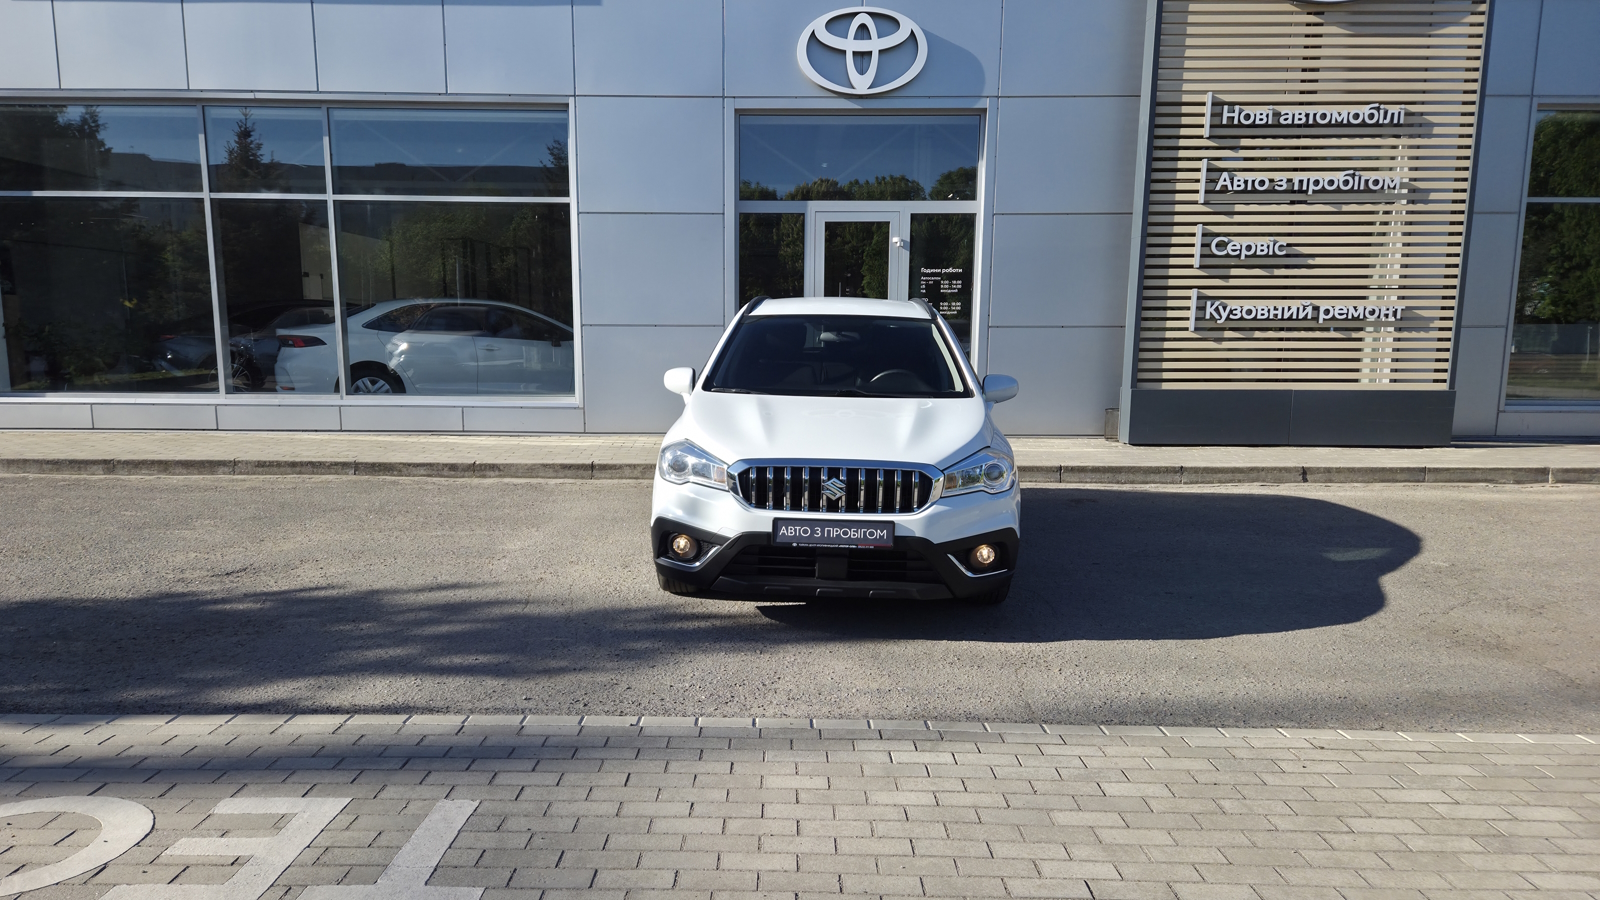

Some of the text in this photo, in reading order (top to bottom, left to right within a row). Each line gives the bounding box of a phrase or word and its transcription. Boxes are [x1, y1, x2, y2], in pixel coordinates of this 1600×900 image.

[1221, 103, 1406, 125] Нові автомобілі
[1215, 169, 1401, 195] Авто з пробігом
[1210, 236, 1288, 260] Сервіс
[1204, 300, 1406, 324] Кузовний ремонт
[779, 526, 887, 539] АВТО З ПРОБІГОМ
